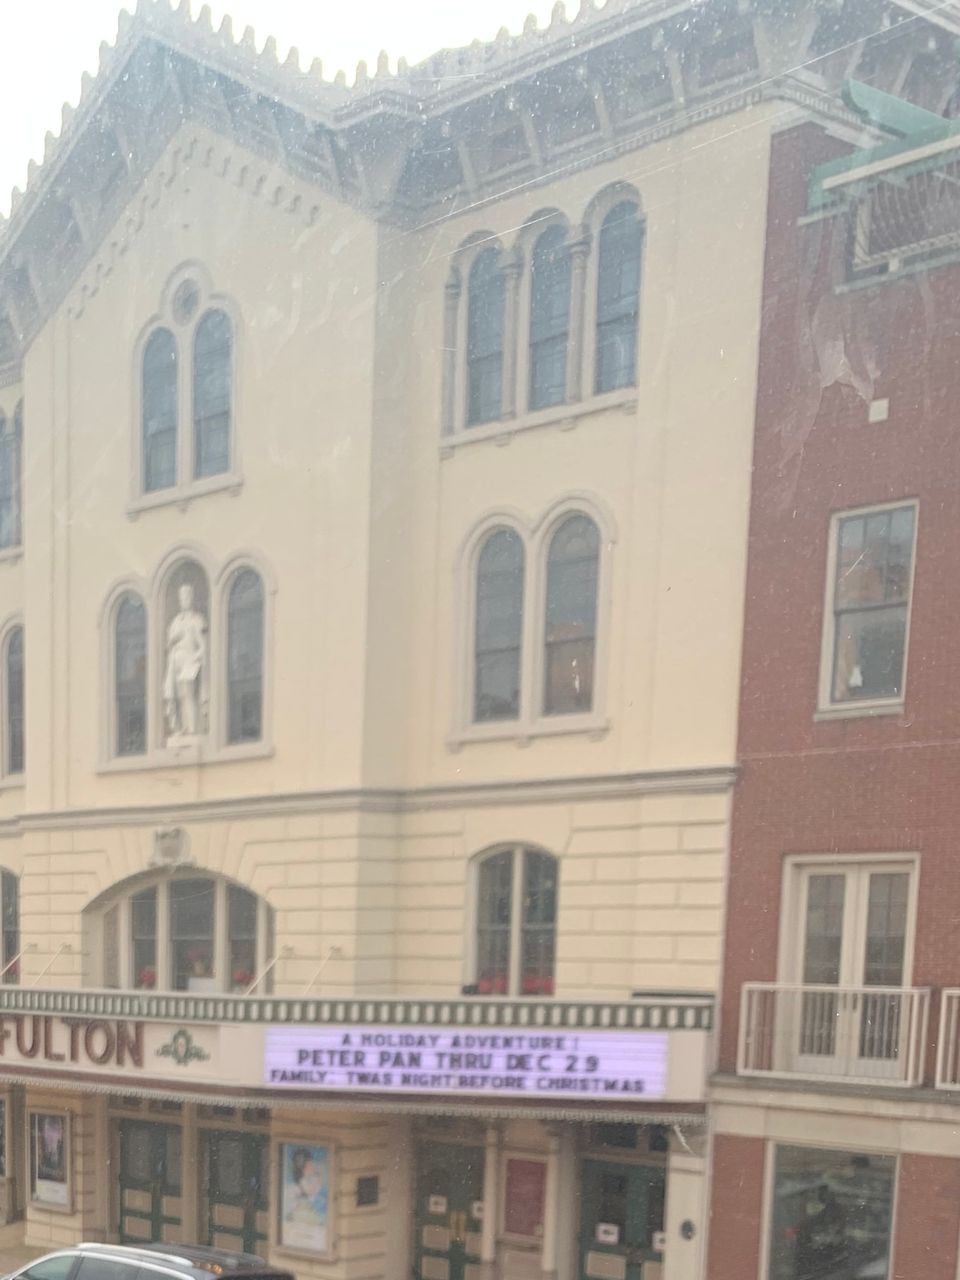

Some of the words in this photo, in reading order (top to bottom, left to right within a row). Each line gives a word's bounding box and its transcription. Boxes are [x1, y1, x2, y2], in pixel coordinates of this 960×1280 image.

[342, 1032, 351, 1047] A
[361, 1033, 439, 1048] HOLIDAY
[297, 1048, 366, 1067] PETER
[379, 1051, 422, 1068] PAN
[436, 1052, 493, 1070] THRU
[506, 1053, 551, 1071] DEC
[401, 1072, 452, 1088] NIGHT
[458, 1074, 525, 1090] BEFORE
[537, 1077, 646, 1093] CHRISTMAS
